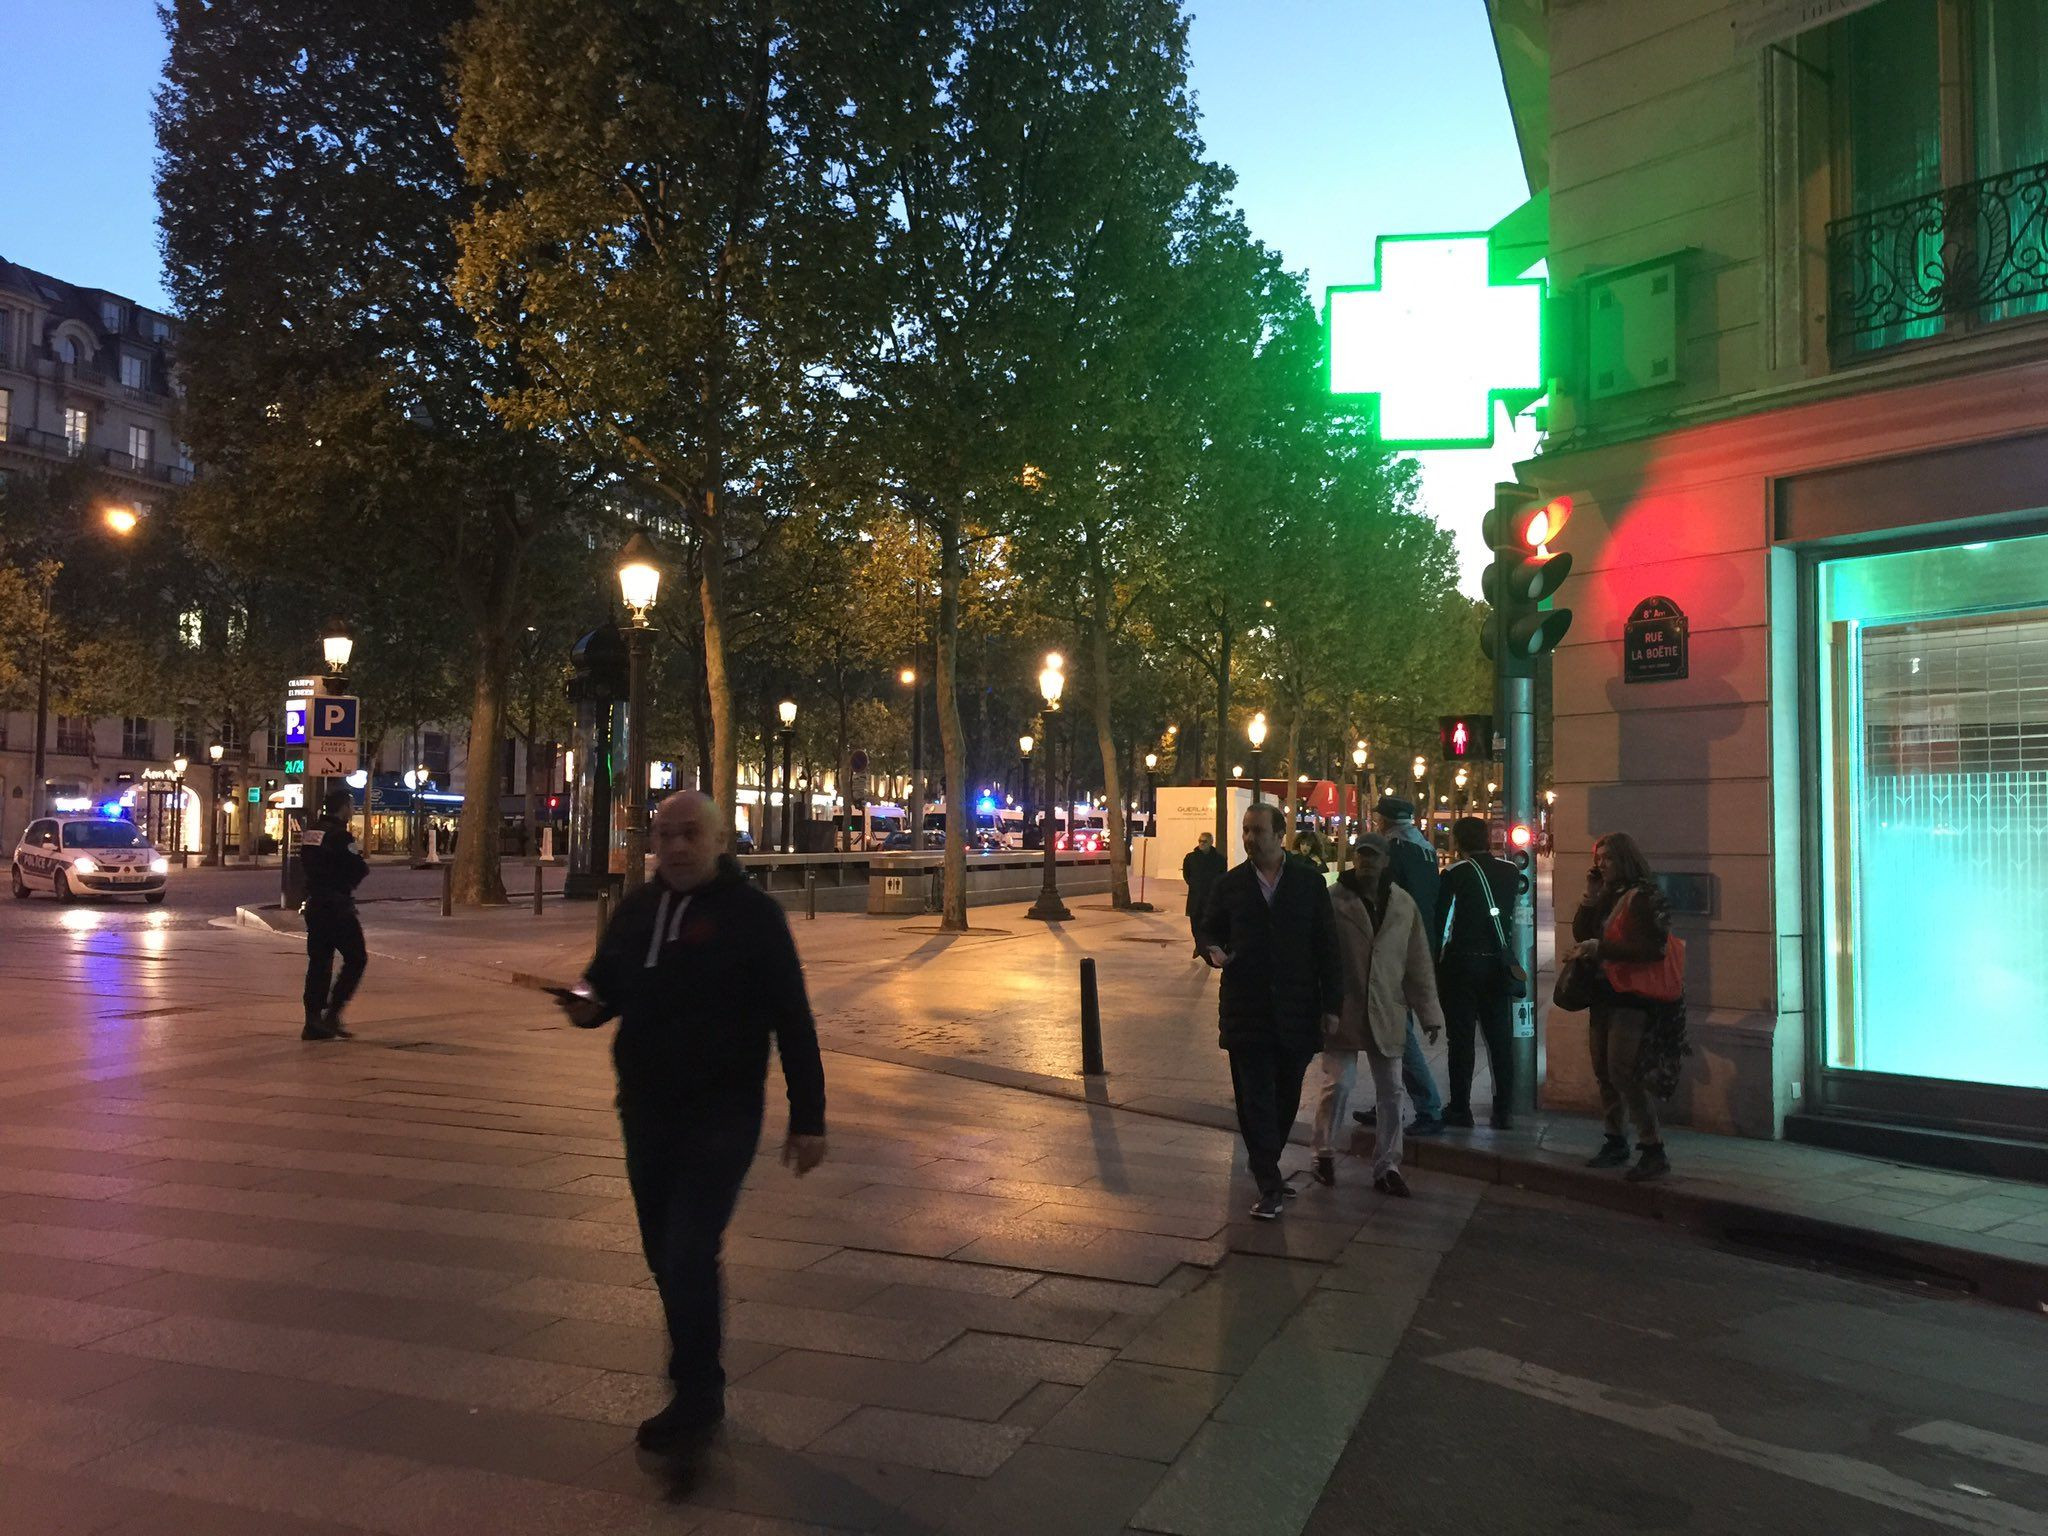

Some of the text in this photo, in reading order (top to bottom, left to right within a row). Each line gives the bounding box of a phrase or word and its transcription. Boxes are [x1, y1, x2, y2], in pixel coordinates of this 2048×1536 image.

[1645, 631, 1663, 643] RUE
[1632, 650, 1643, 660] LA
[286, 711, 300, 735] P
[324, 704, 346, 731] P
[285, 760, 304, 774] 24/24
